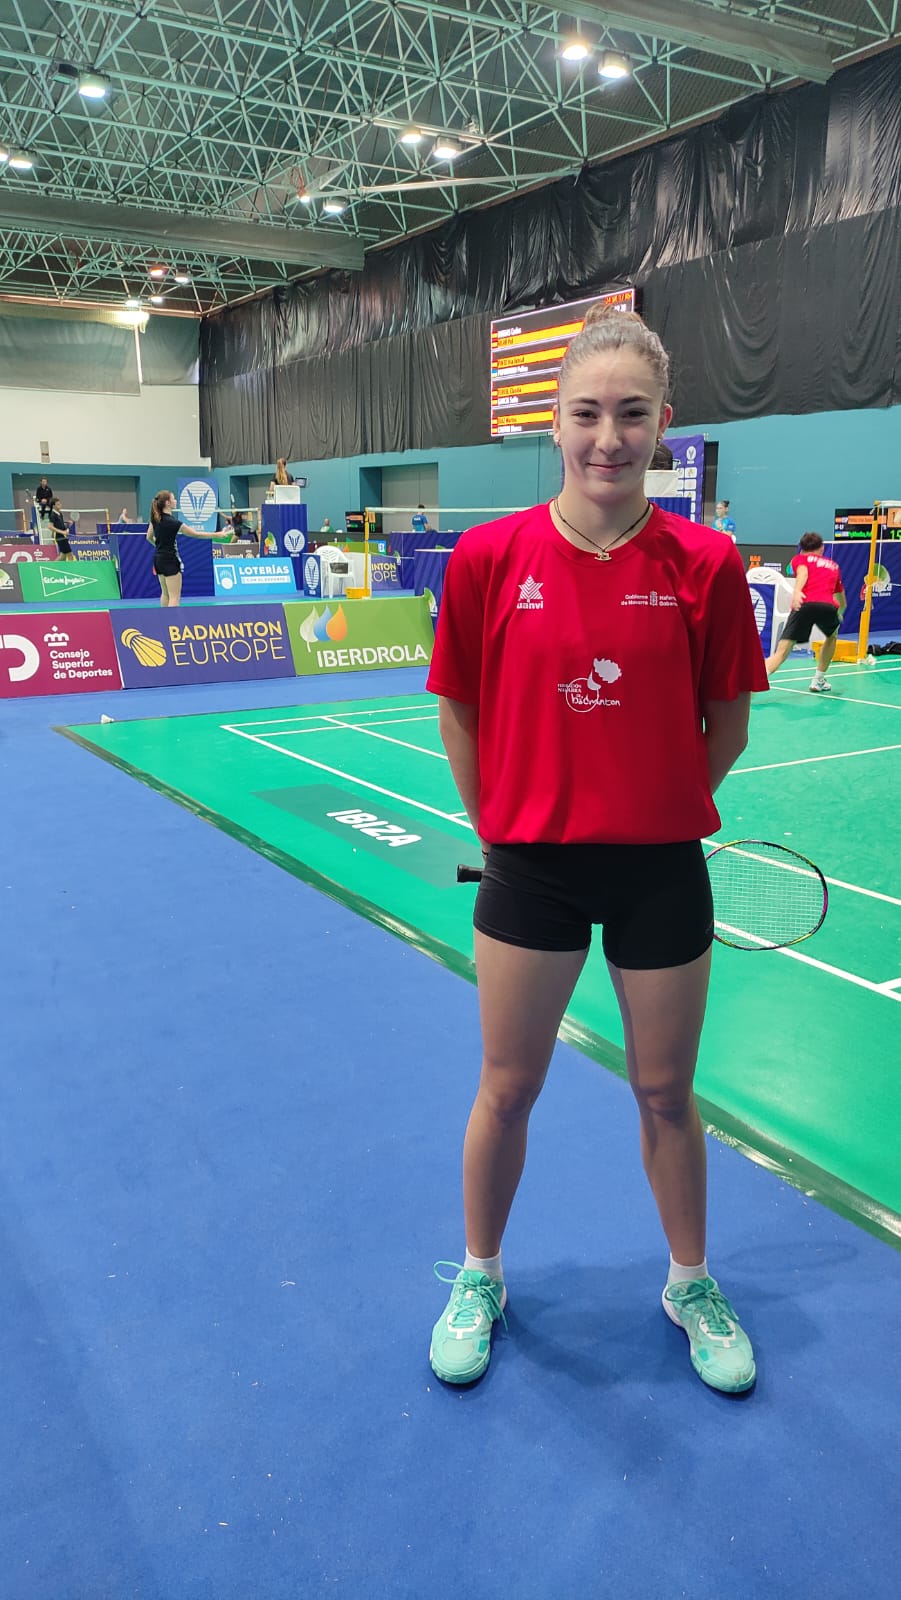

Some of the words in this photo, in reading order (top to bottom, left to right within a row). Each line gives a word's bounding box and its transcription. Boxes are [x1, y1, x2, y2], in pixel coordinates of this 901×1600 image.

[238, 563, 289, 575] LOTERÍAS
[168, 620, 283, 641] BADMINTON
[49, 648, 90, 661] Consejo
[171, 637, 286, 666] EUROPE
[316, 644, 429, 668] IBERDROLA
[52, 659, 94, 671] Superior
[53, 670, 67, 680] de
[68, 668, 113, 680] Deportes
[325, 808, 422, 847] IBIZA
